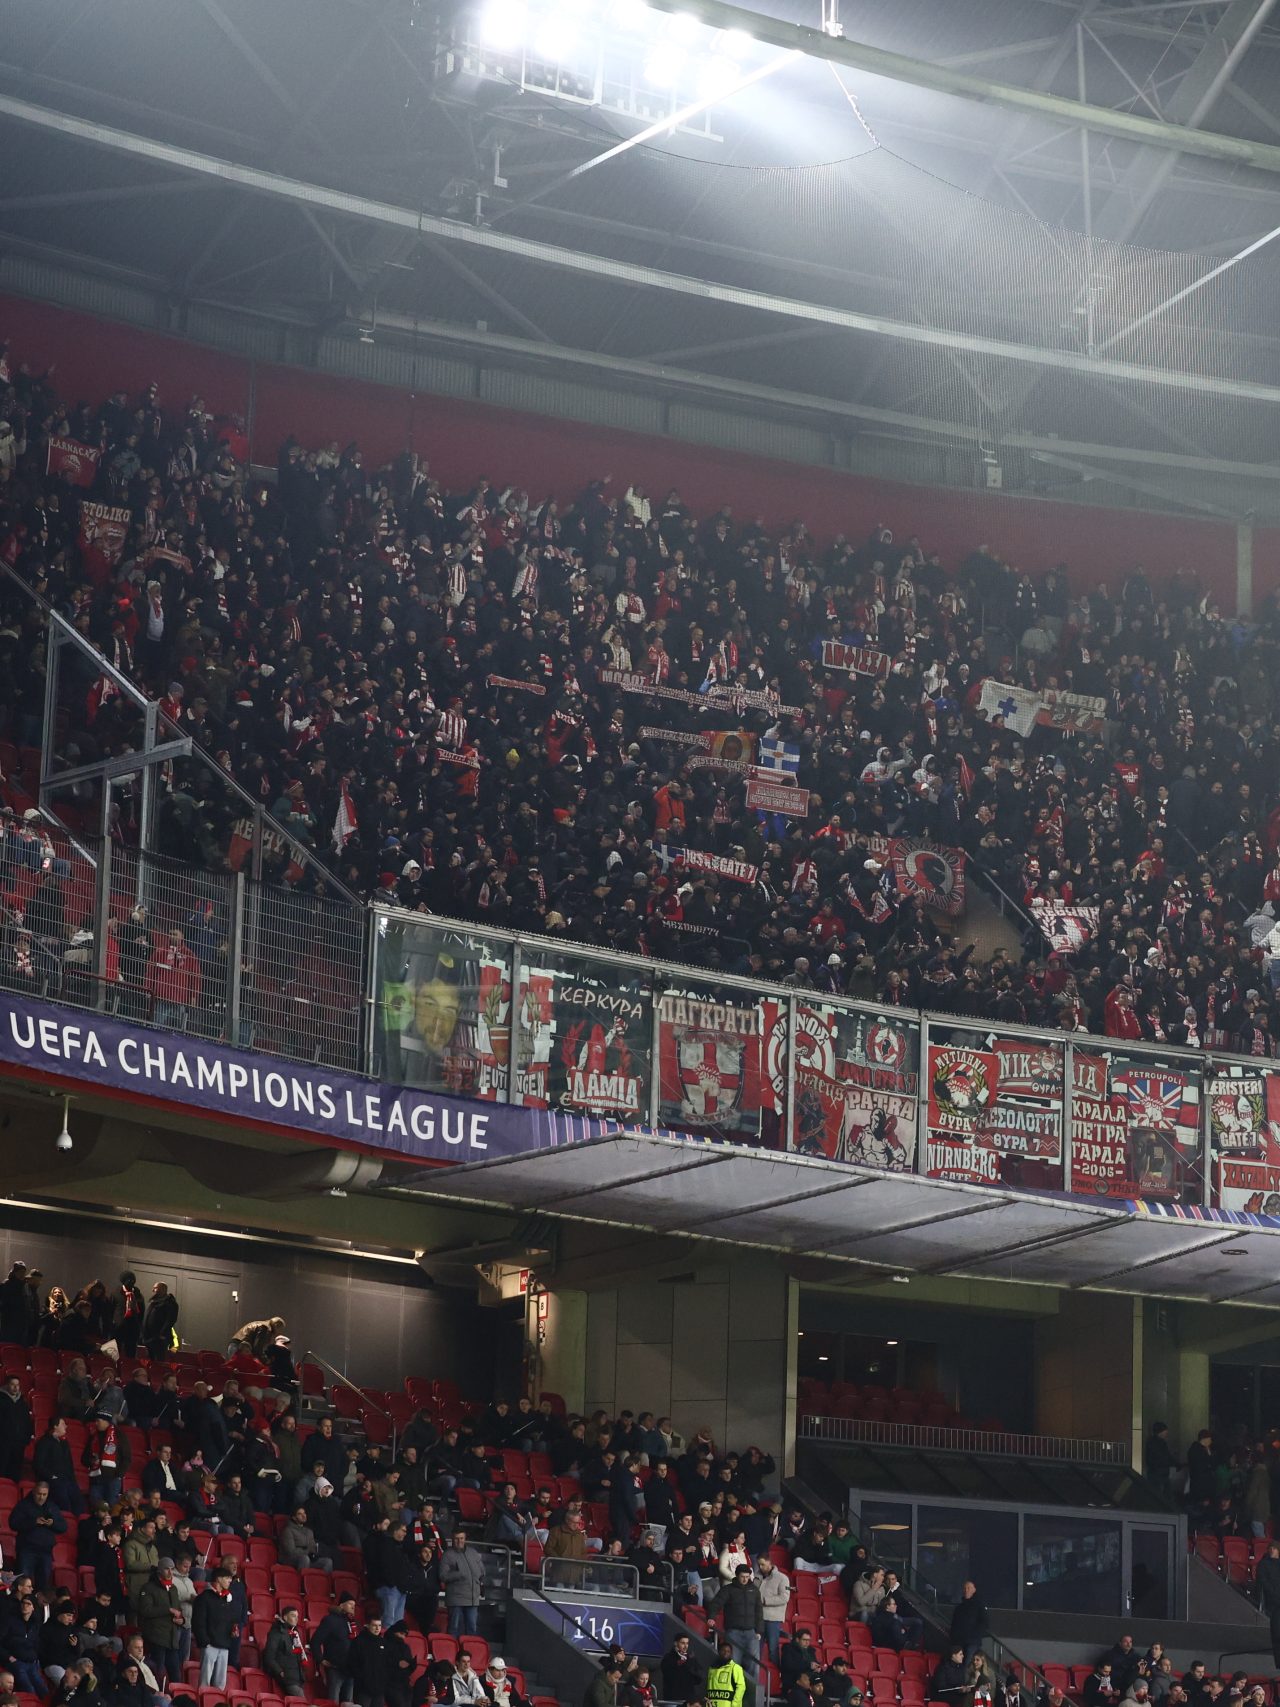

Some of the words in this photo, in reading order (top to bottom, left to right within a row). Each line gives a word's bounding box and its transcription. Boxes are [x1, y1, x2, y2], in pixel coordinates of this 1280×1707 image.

[559, 986, 643, 1020] ΚΕΡΚΥΡΑ
[660, 995, 757, 1035] ΠΑΓΚΡΑΤΙ
[934, 1050, 988, 1075] ΜΥΤΙΛΗΝΗ
[9, 1011, 107, 1068] UEFA
[118, 1038, 336, 1119] CHAMPIONS
[345, 1090, 489, 1150] LEAGUE
[572, 1071, 638, 1109] ΛΑΜΙΑ
[1129, 1071, 1182, 1085] PETROUPOLI
[848, 1090, 915, 1122] PATRA
[1033, 1139, 1041, 1152] 7
[1220, 1132, 1249, 1147] GATE
[574, 1615, 614, 1641] 116
